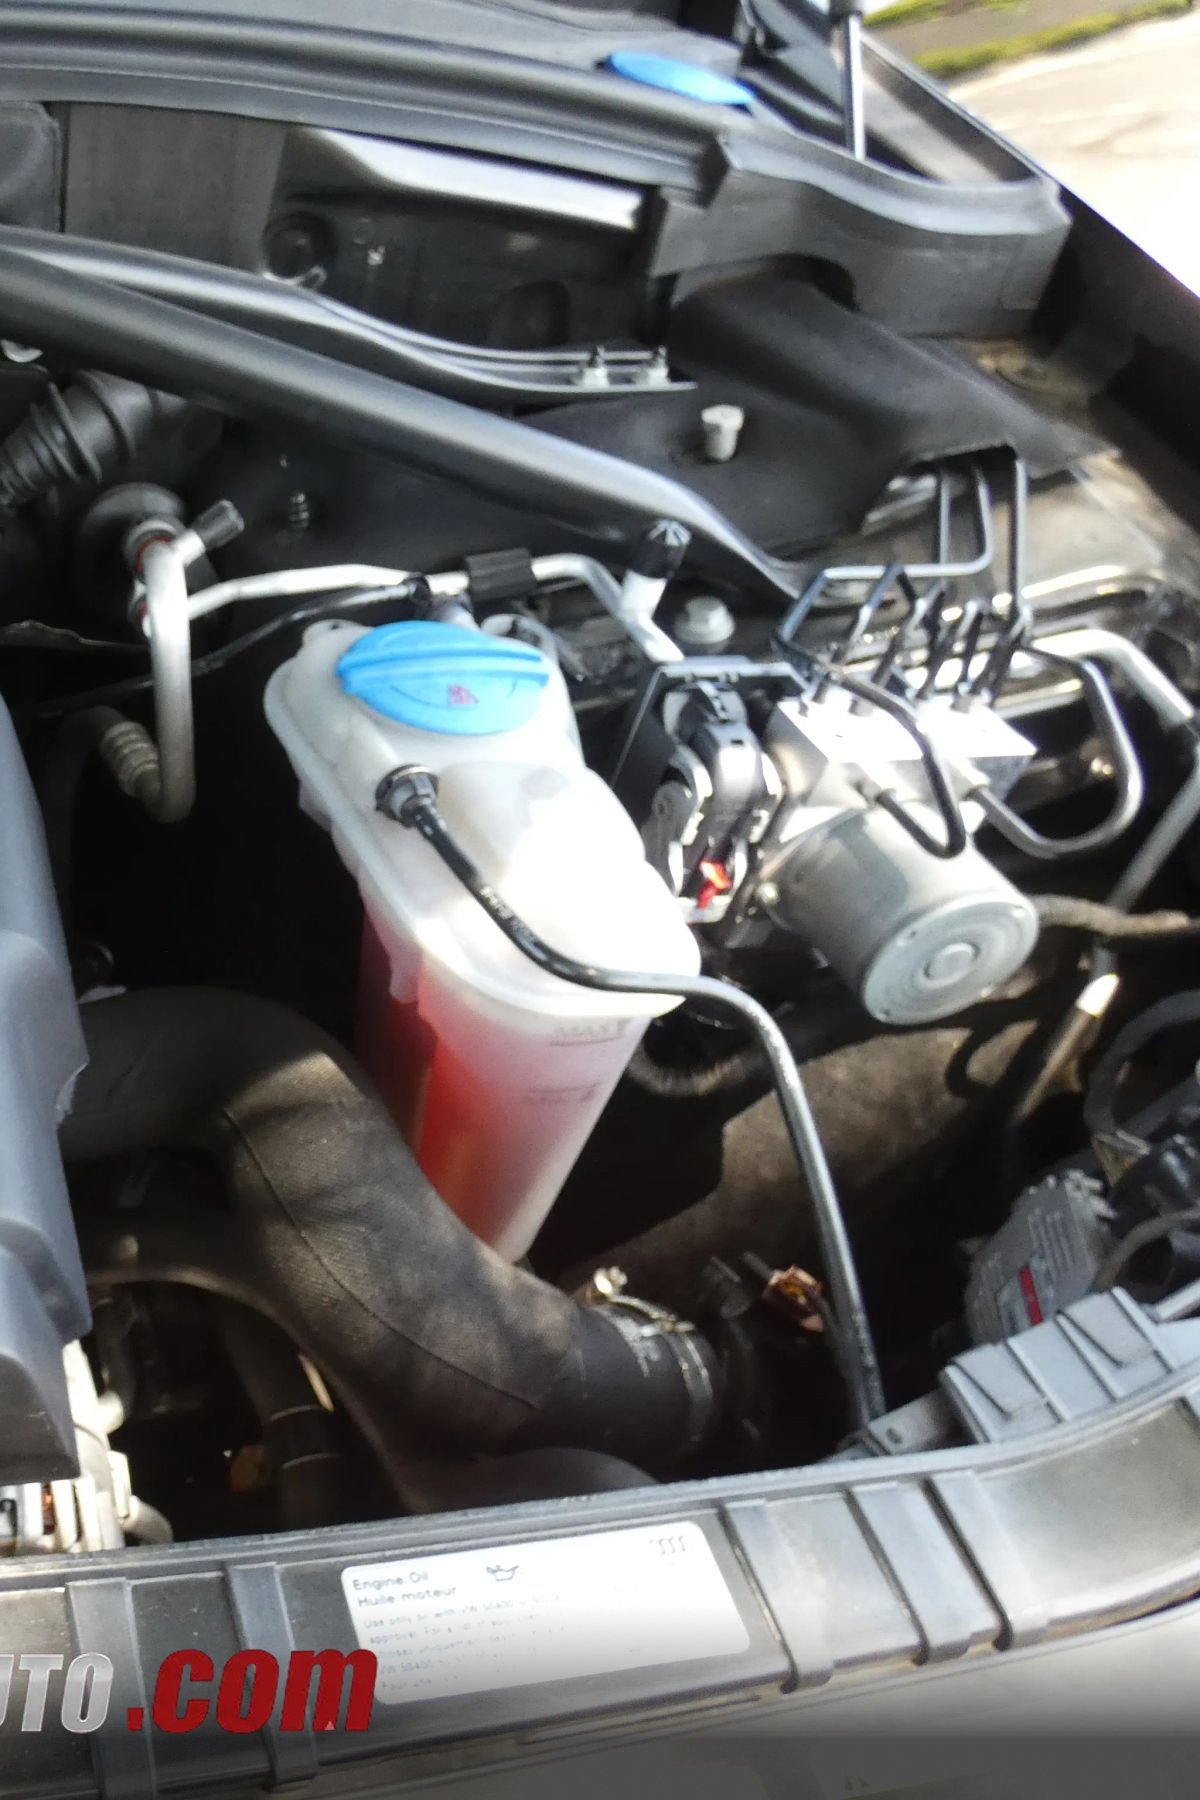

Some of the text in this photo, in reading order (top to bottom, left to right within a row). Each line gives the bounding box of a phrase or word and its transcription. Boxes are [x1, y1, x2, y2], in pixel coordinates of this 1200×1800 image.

[352, 1571, 428, 1591] Engine Oil
[357, 1587, 456, 1607] Huile moteur
